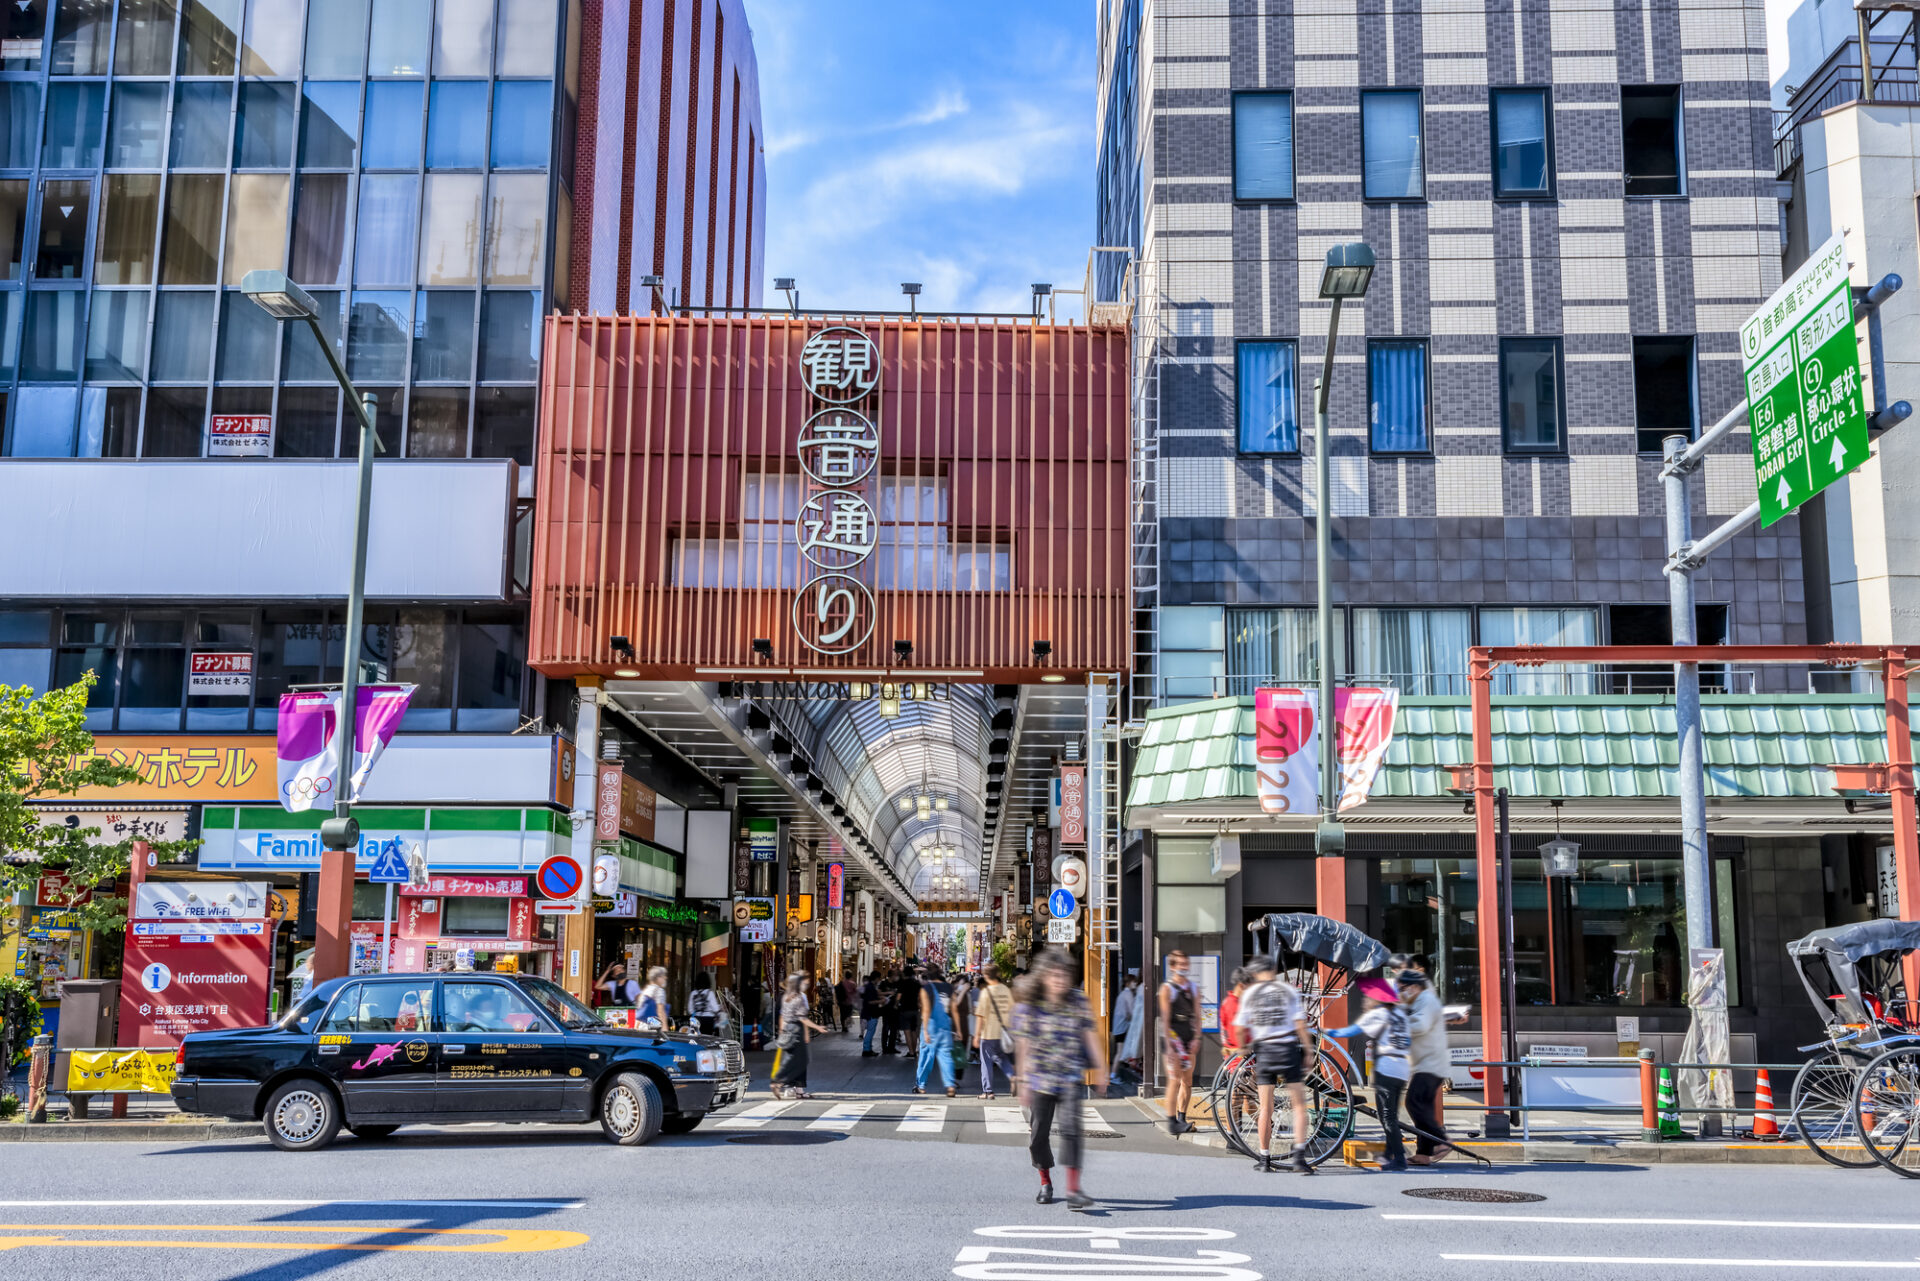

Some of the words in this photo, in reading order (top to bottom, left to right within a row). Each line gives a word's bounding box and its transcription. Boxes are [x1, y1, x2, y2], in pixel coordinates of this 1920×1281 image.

[1796, 243, 1842, 294] SHUTOKO
[1748, 329, 1756, 350] 6
[1762, 291, 1797, 338] 首都高
[1801, 302, 1845, 354] 駒形入口
[1751, 351, 1790, 400] 向島入口
[1806, 364, 1820, 385] C1
[1806, 365, 1857, 426] 都心環状
[215, 418, 269, 432] テナント募集
[1757, 406, 1772, 428] E6
[1758, 412, 1798, 462] 常磐道
[1811, 410, 1845, 445] Circle
[1849, 398, 1858, 417] 1
[1757, 451, 1785, 489] JOBAN
[1787, 438, 1804, 464] EXP
[797, 334, 878, 646] 観音通り
[195, 656, 252, 670] テナント募集
[1256, 721, 1290, 813] 2020
[113, 817, 168, 837] 中華そば
[600, 771, 619, 835] 観音通り
[1065, 772, 1081, 838] 観音通り
[185, 907, 205, 916] FREE
[448, 880, 524, 894] チケット売場
[177, 972, 248, 984] Information
[155, 1005, 228, 1015] 台東区浅草1丁目
